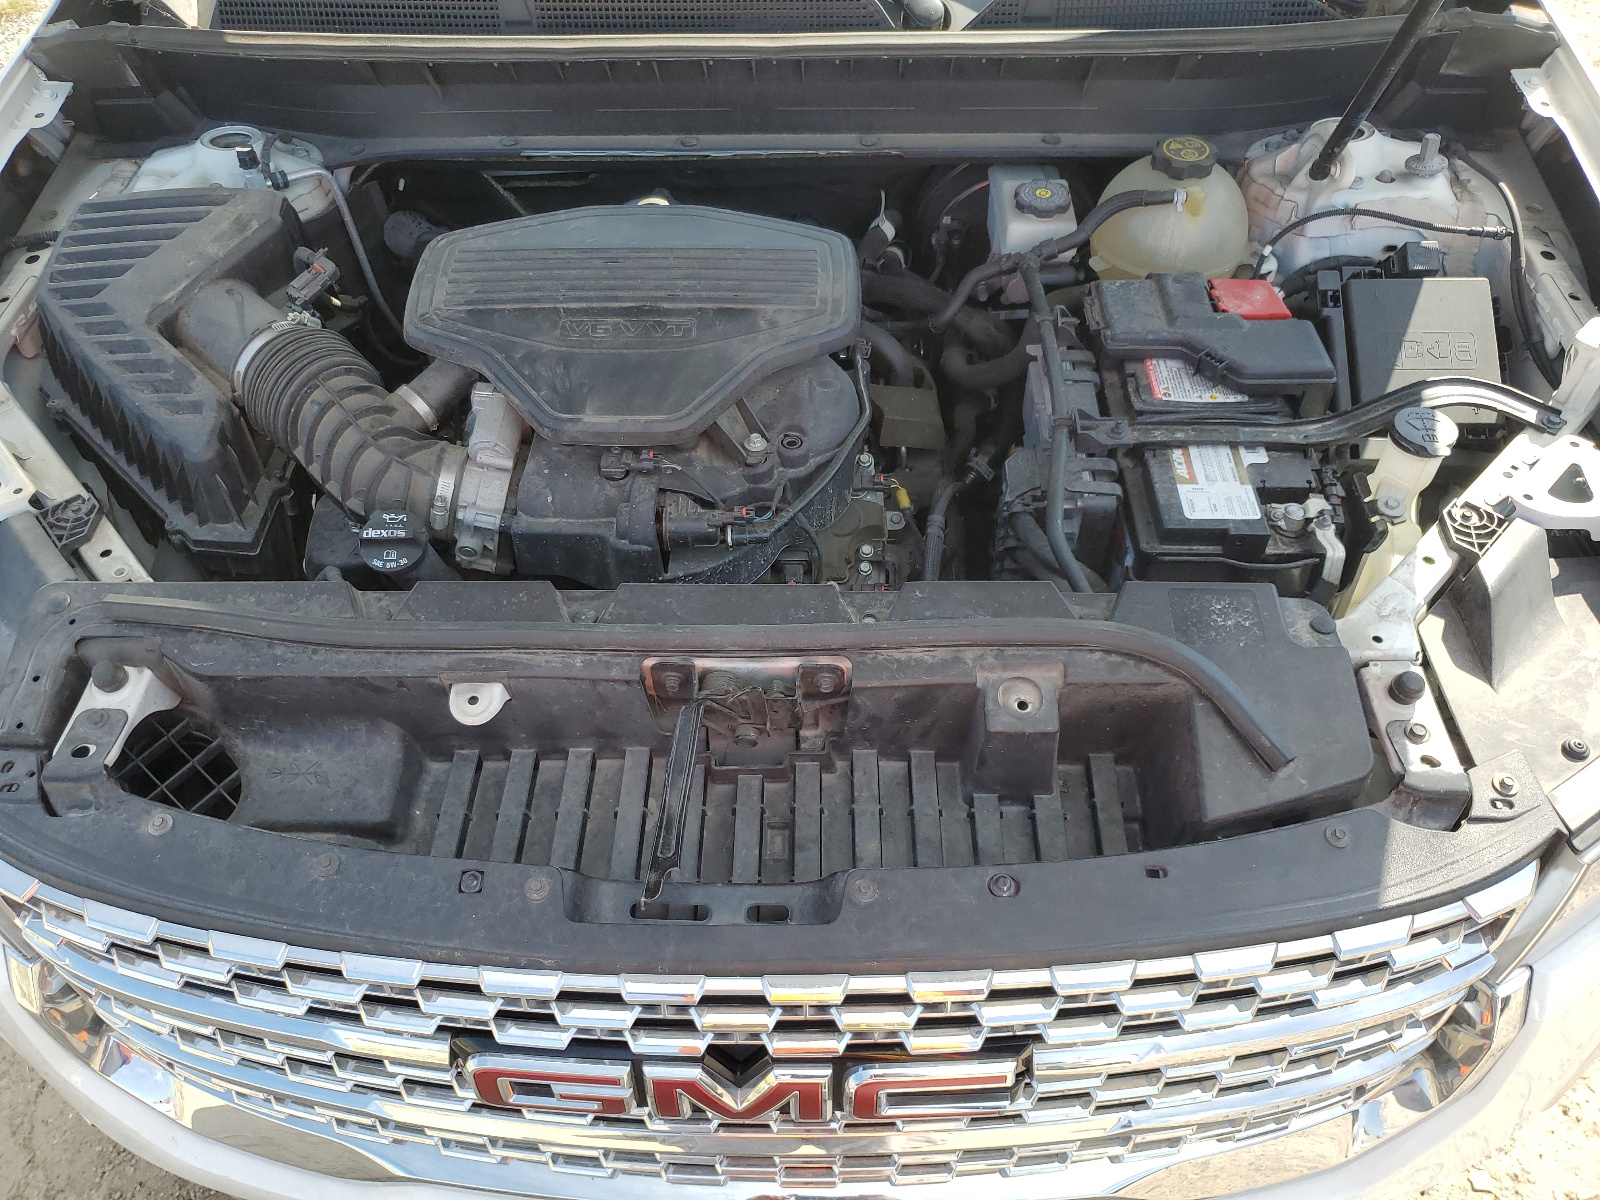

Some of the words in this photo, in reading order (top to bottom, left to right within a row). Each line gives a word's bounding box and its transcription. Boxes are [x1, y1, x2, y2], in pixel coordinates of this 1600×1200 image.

[566, 321, 613, 337] V6
[619, 321, 690, 337] VVT
[362, 527, 408, 538] dexos
[372, 558, 385, 568] SAE
[386, 557, 408, 569] 5W-30
[470, 1054, 1018, 1122] GMC
